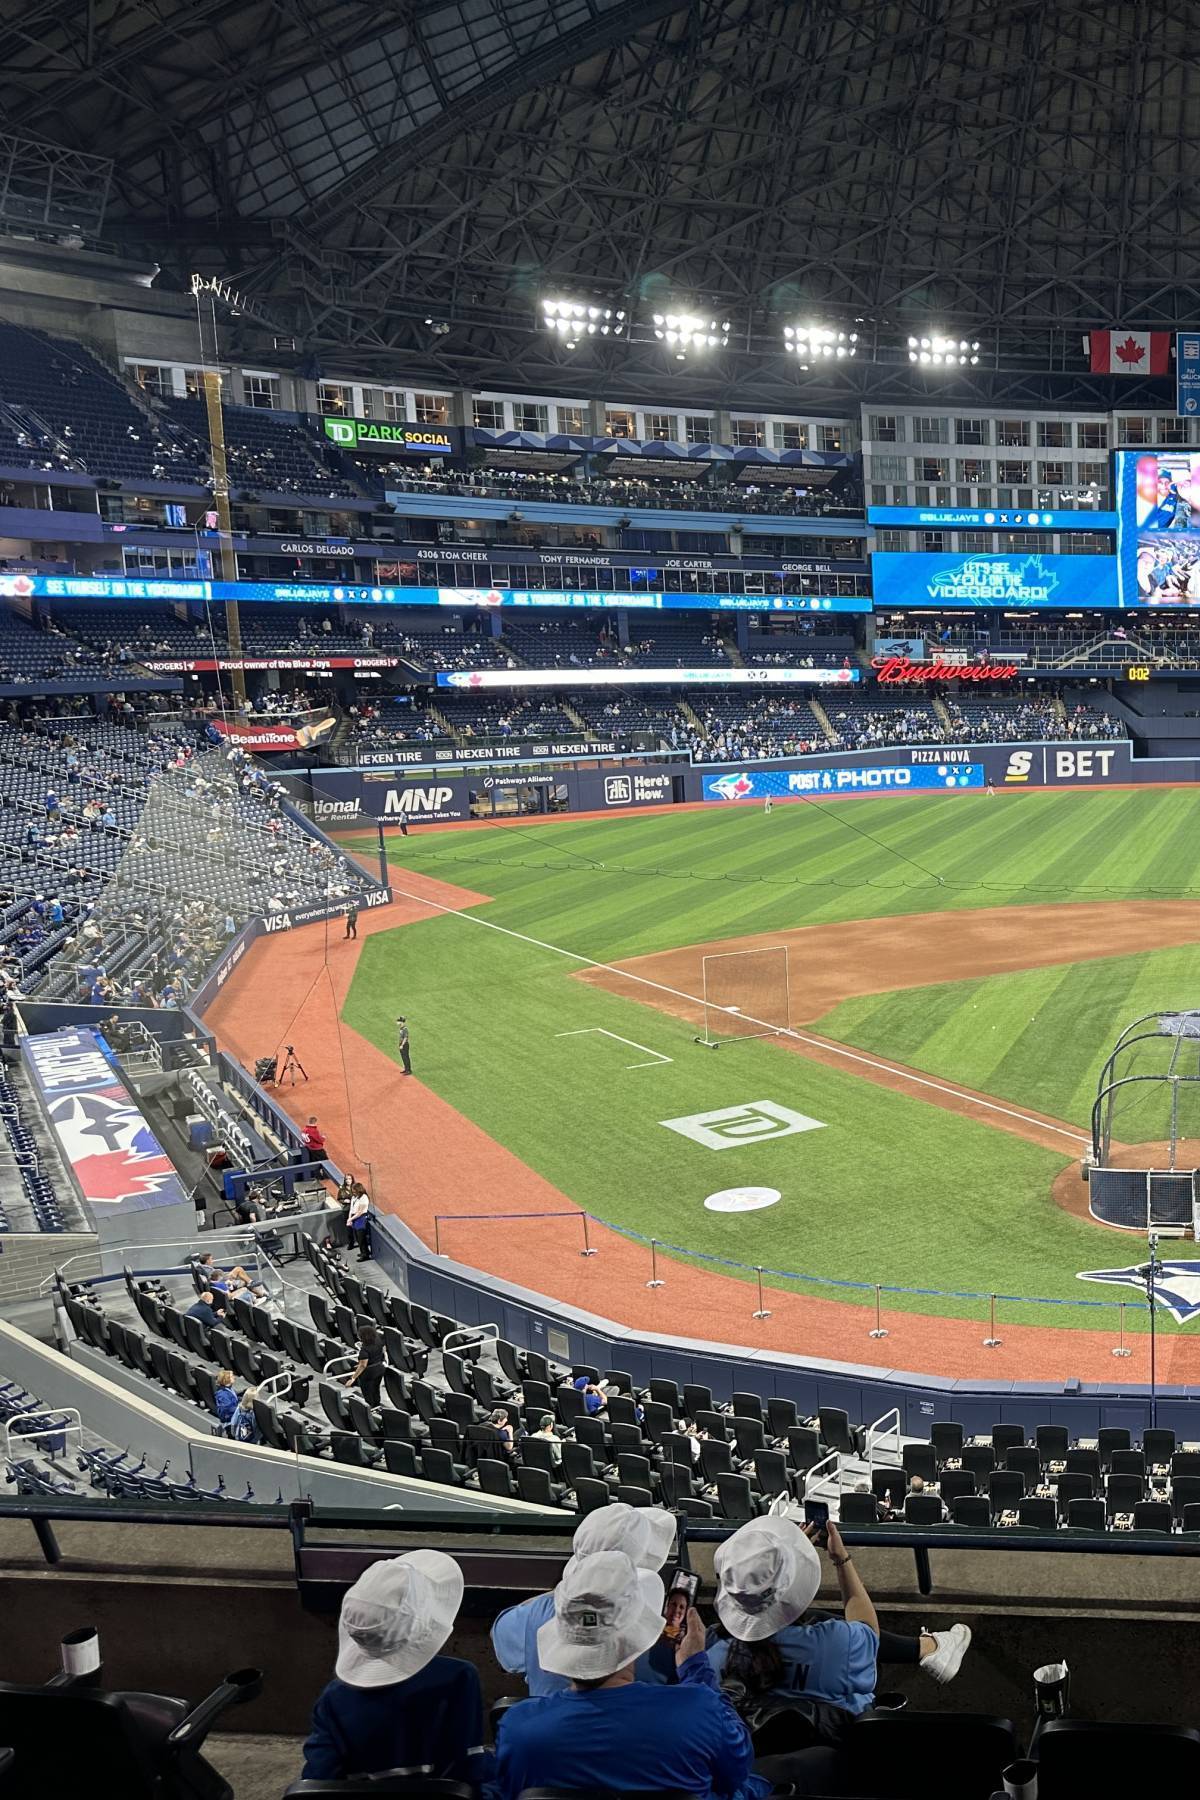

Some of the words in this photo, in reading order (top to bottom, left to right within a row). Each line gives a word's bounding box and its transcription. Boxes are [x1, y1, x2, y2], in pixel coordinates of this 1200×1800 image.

[327, 423, 354, 442] TD
[357, 424, 404, 441] PARK
[405, 431, 451, 446] SOCIAL
[280, 543, 314, 554] CARLOS
[316, 544, 354, 555] DELGADO
[417, 550, 438, 559] 4306
[440, 551, 460, 560] TOM
[461, 551, 488, 561] CHEEK
[540, 555, 562, 564] TONY
[565, 556, 610, 565] FERNANDEZ
[665, 560, 680, 568] JOE
[683, 560, 713, 569] CARTER
[781, 563, 813, 572] GEORGE
[815, 564, 832, 572] BELL
[991, 561, 1011, 574] SEE
[949, 574, 987, 586] YOU
[153, 661, 183, 671] ROGERS
[219, 660, 243, 669] Proud
[244, 661, 268, 669] owner
[269, 660, 277, 669] of
[278, 660, 292, 669] the
[292, 660, 310, 668] Blue
[312, 659, 331, 670] Jays
[361, 659, 387, 667] ROGERS
[871, 657, 1018, 682] Budweiser
[1128, 667, 1150, 681] 0:02
[231, 732, 294, 745] BeautiTone
[456, 748, 493, 759] NEXEN
[495, 747, 521, 758] TIRE
[552, 744, 589, 755] NEXEN
[591, 743, 616, 754] TIRE
[396, 751, 422, 763] TIRE
[911, 750, 941, 763] PIZZA
[943, 749, 970, 763] NOVA
[1055, 750, 1115, 778] BET
[495, 777, 526, 786] Pathways
[527, 775, 554, 784] Alliance
[634, 774, 670, 787] Here's
[788, 773, 819, 790] POST
[837, 768, 911, 787] PHOTO
[383, 787, 453, 814] MNP
[634, 788, 664, 800] How.
[315, 814, 327, 822] Car
[330, 812, 358, 821] Rental
[377, 815, 407, 823] Wherev
[408, 813, 434, 821] Business
[434, 811, 450, 819] Takes
[450, 810, 461, 818] You
[364, 890, 389, 907] VISA
[261, 913, 292, 932] VISA
[294, 907, 326, 921] everywhere
[698, 1107, 792, 1139] TD
